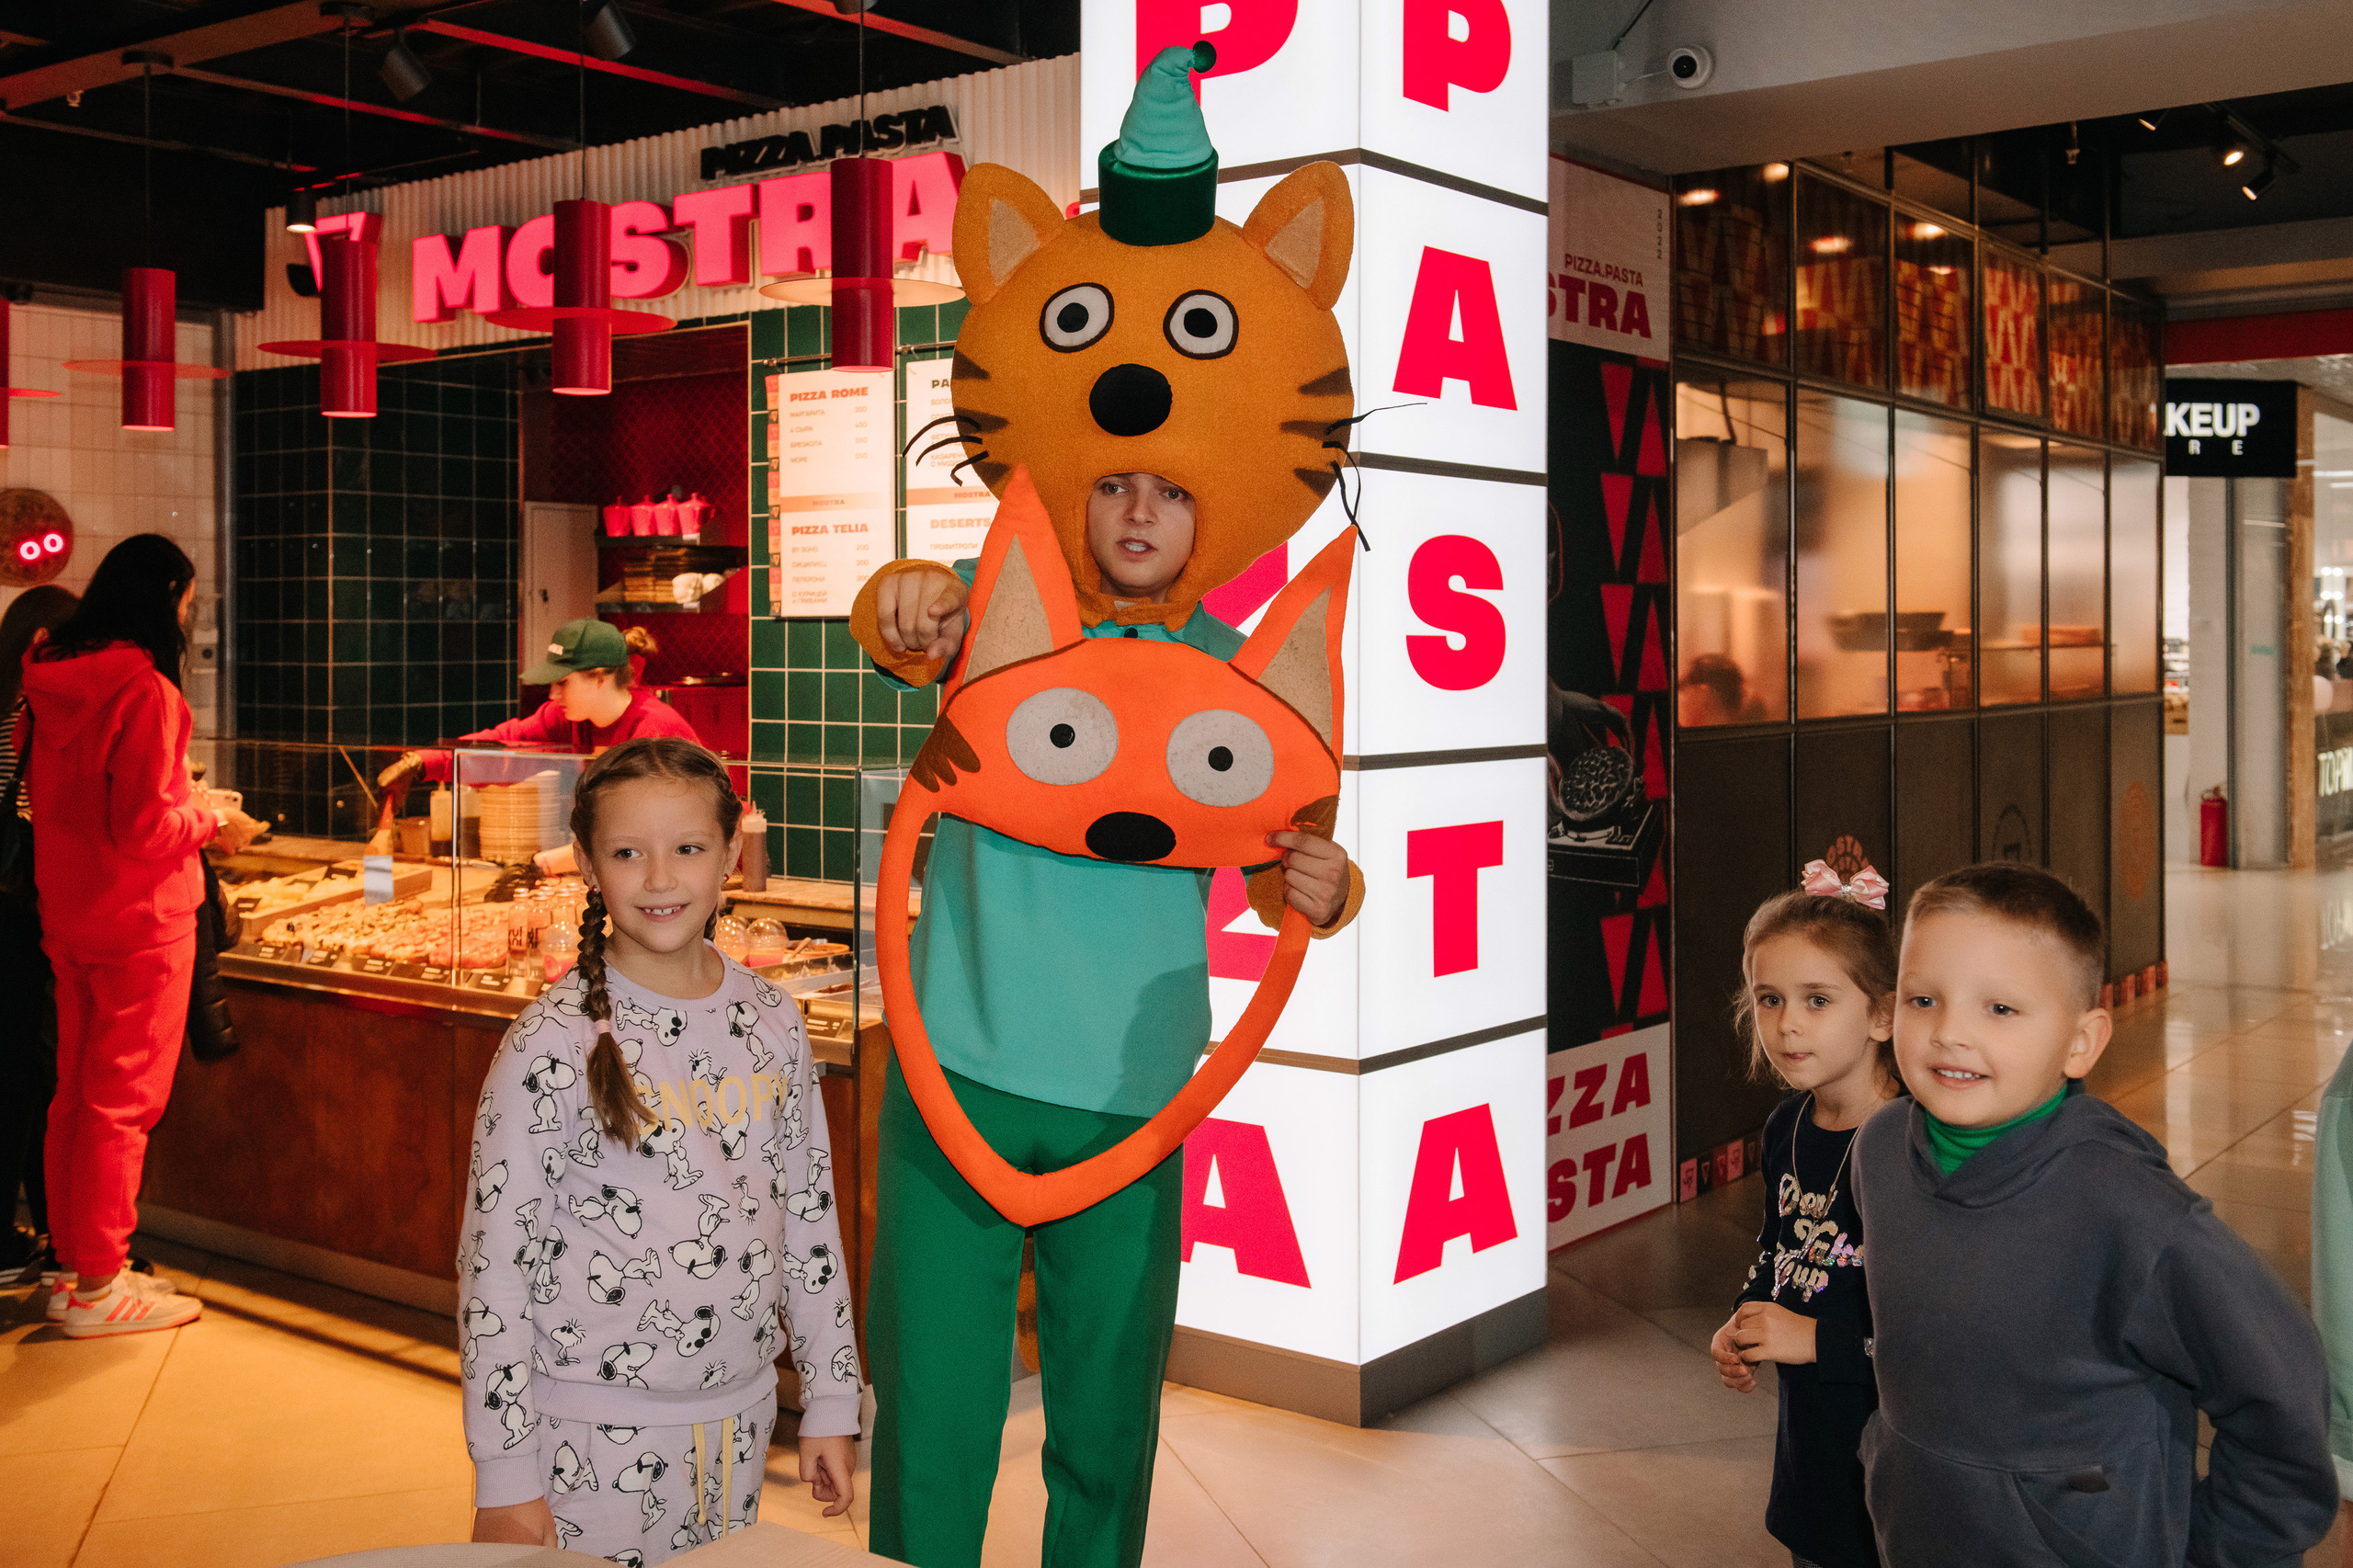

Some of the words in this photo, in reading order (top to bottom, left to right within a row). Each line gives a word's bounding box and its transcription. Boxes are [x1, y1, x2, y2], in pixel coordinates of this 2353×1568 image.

[790, 391, 827, 402] PIZZA
[831, 387, 869, 399] ROME
[2163, 402, 2261, 437] KEUP
[954, 491, 991, 499] MOSTRA
[791, 525, 829, 535] PIZZA
[833, 523, 869, 534] TELIA
[930, 517, 992, 529] DESERTS
